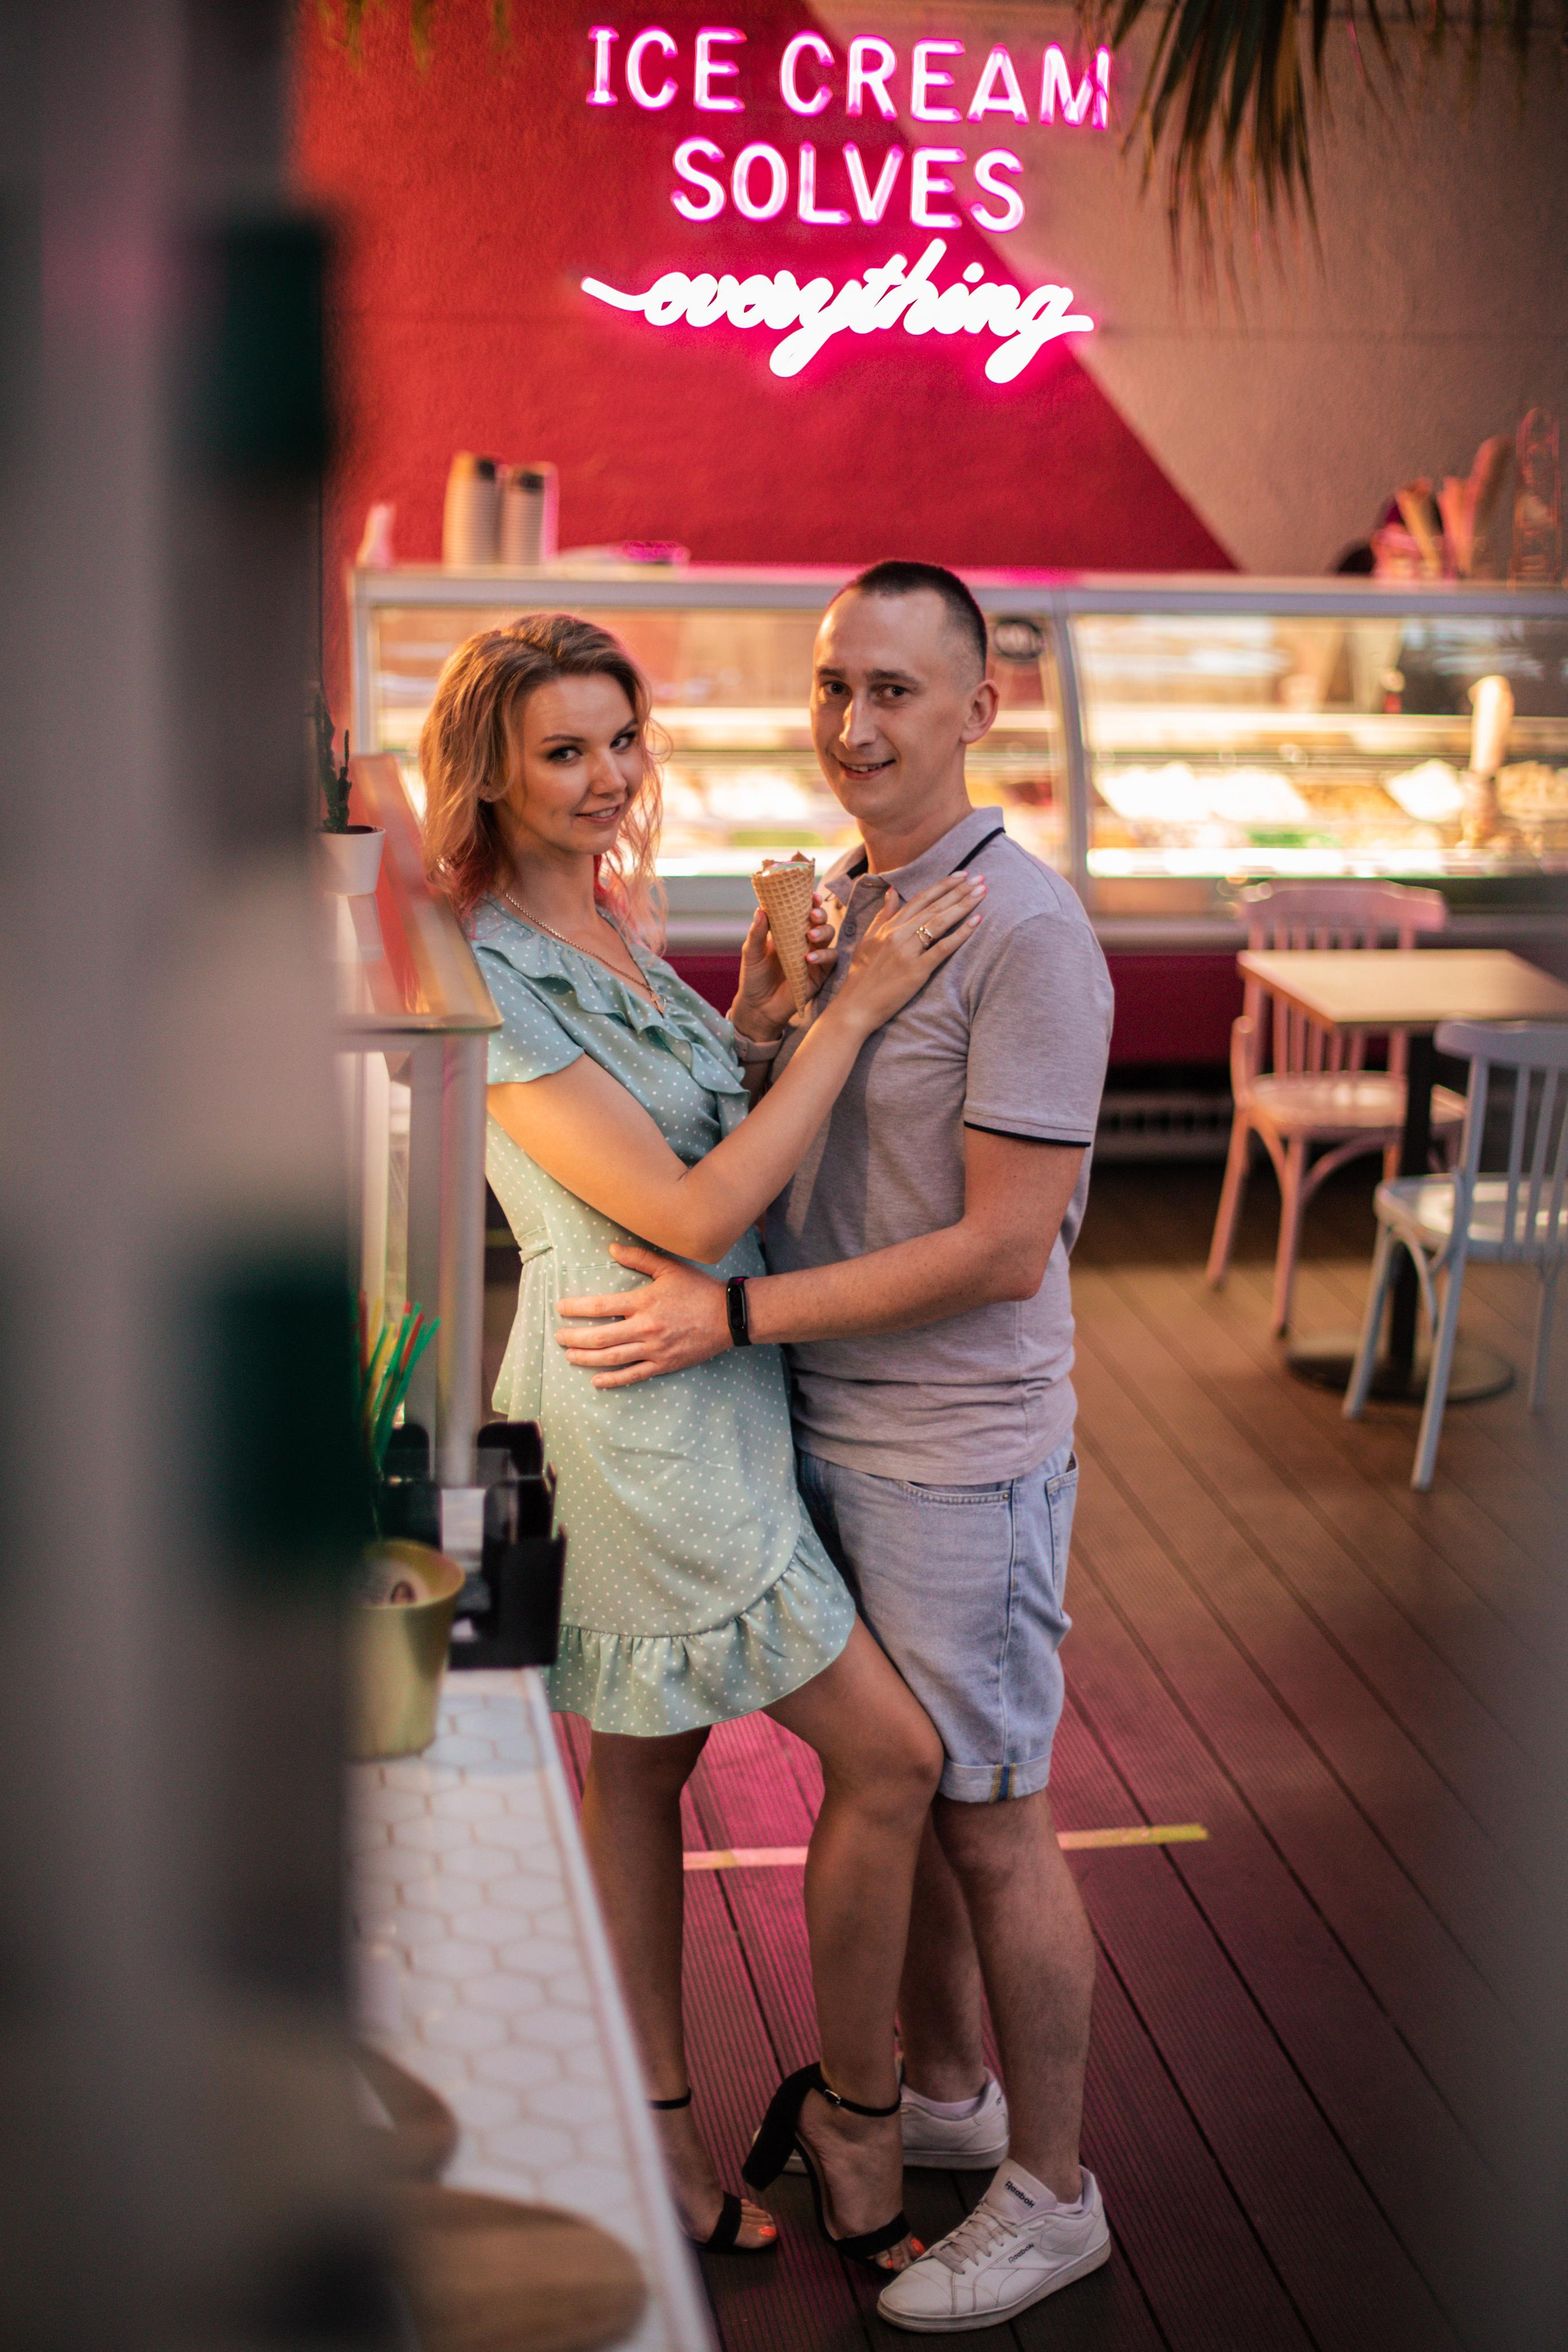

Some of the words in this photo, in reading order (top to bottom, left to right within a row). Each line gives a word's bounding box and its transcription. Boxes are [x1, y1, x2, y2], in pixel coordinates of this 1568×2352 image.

[586, 26, 747, 113] ICE
[778, 31, 1110, 130] CREAM
[670, 136, 1027, 233] SOLVES
[581, 238, 1095, 384] everything
[1005, 2180, 1035, 2208] Reebok
[1008, 2243, 1035, 2264] Reebok
